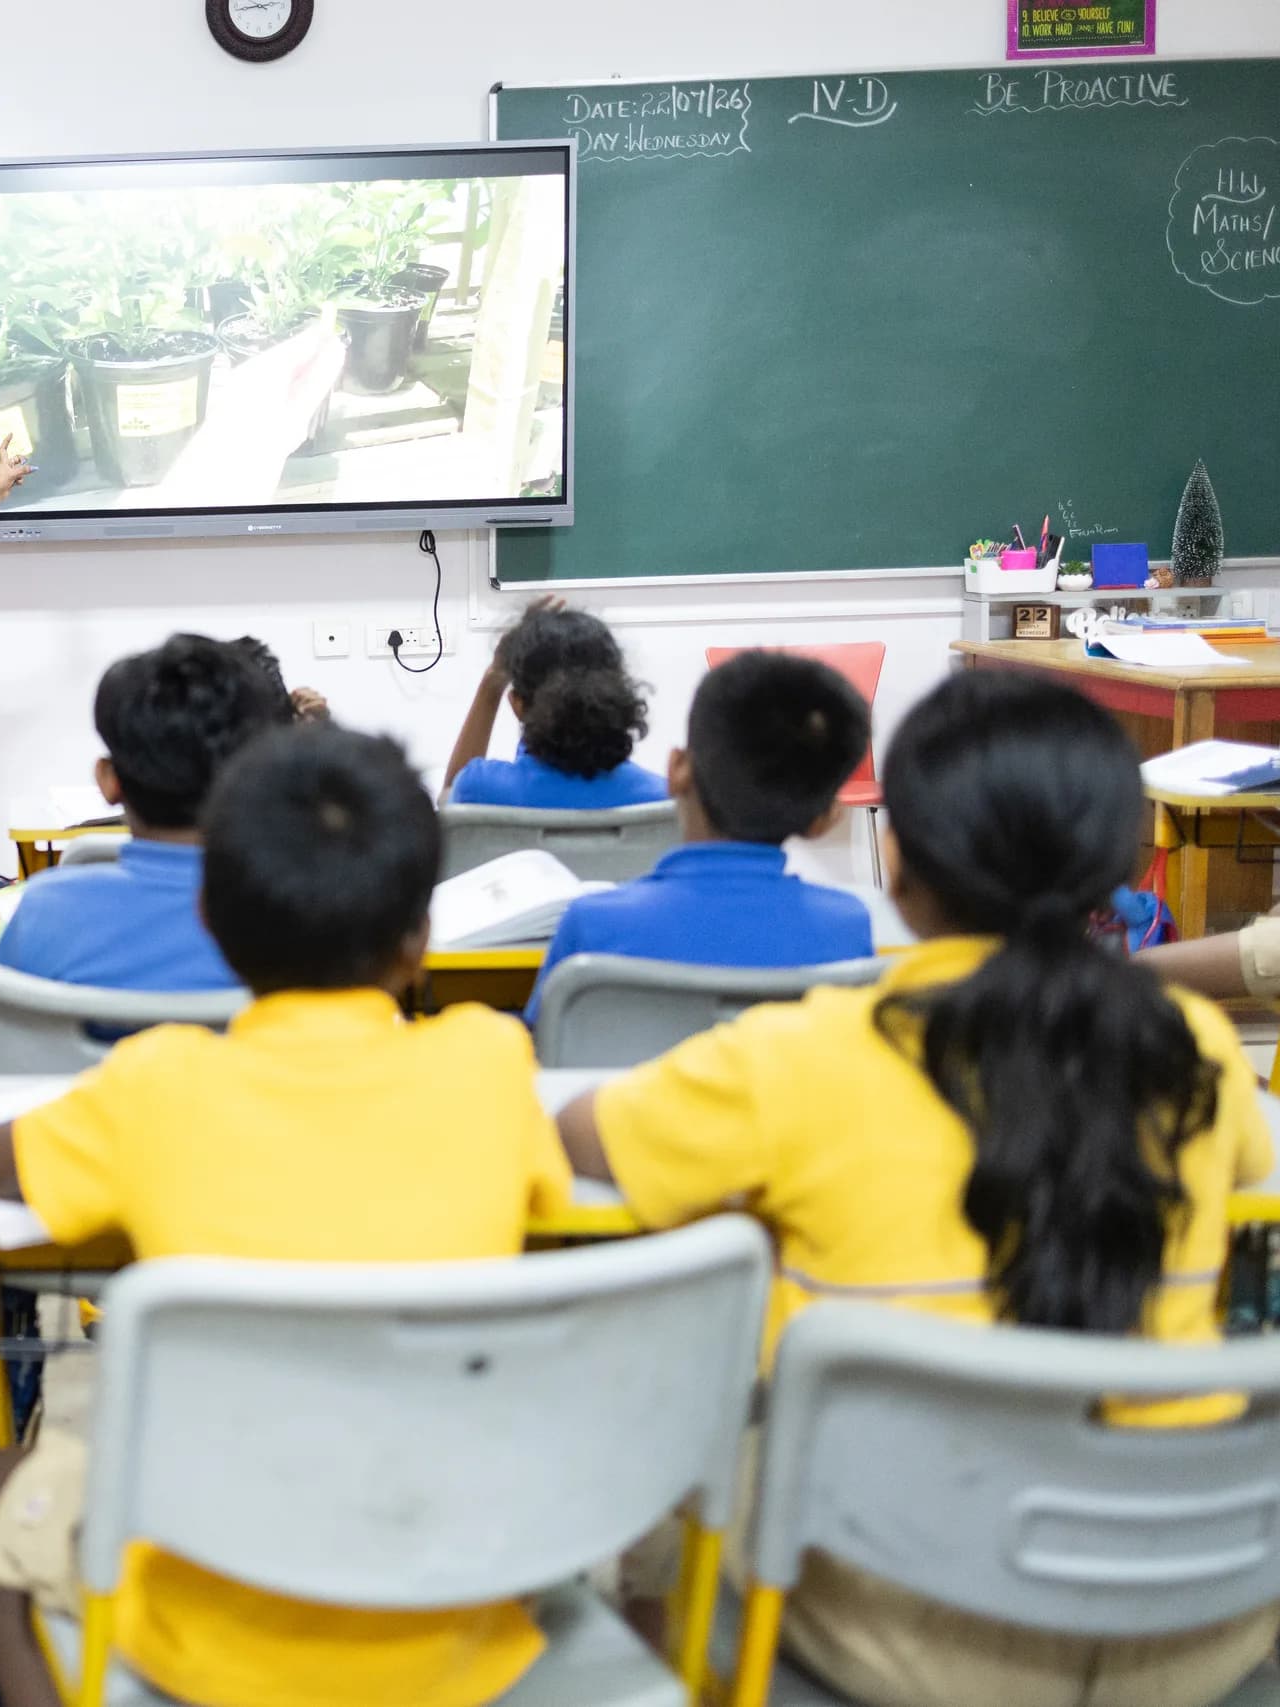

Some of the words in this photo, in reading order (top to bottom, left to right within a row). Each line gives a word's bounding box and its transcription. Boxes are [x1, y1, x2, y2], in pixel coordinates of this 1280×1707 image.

[1033, 9, 1059, 22] BELIEVE
[1078, 7, 1111, 20] YOURSELF
[1033, 24, 1052, 36] WORK
[1056, 23, 1072, 35] HARD
[1097, 21, 1113, 33] HAVE
[1117, 21, 1134, 33] FUN!
